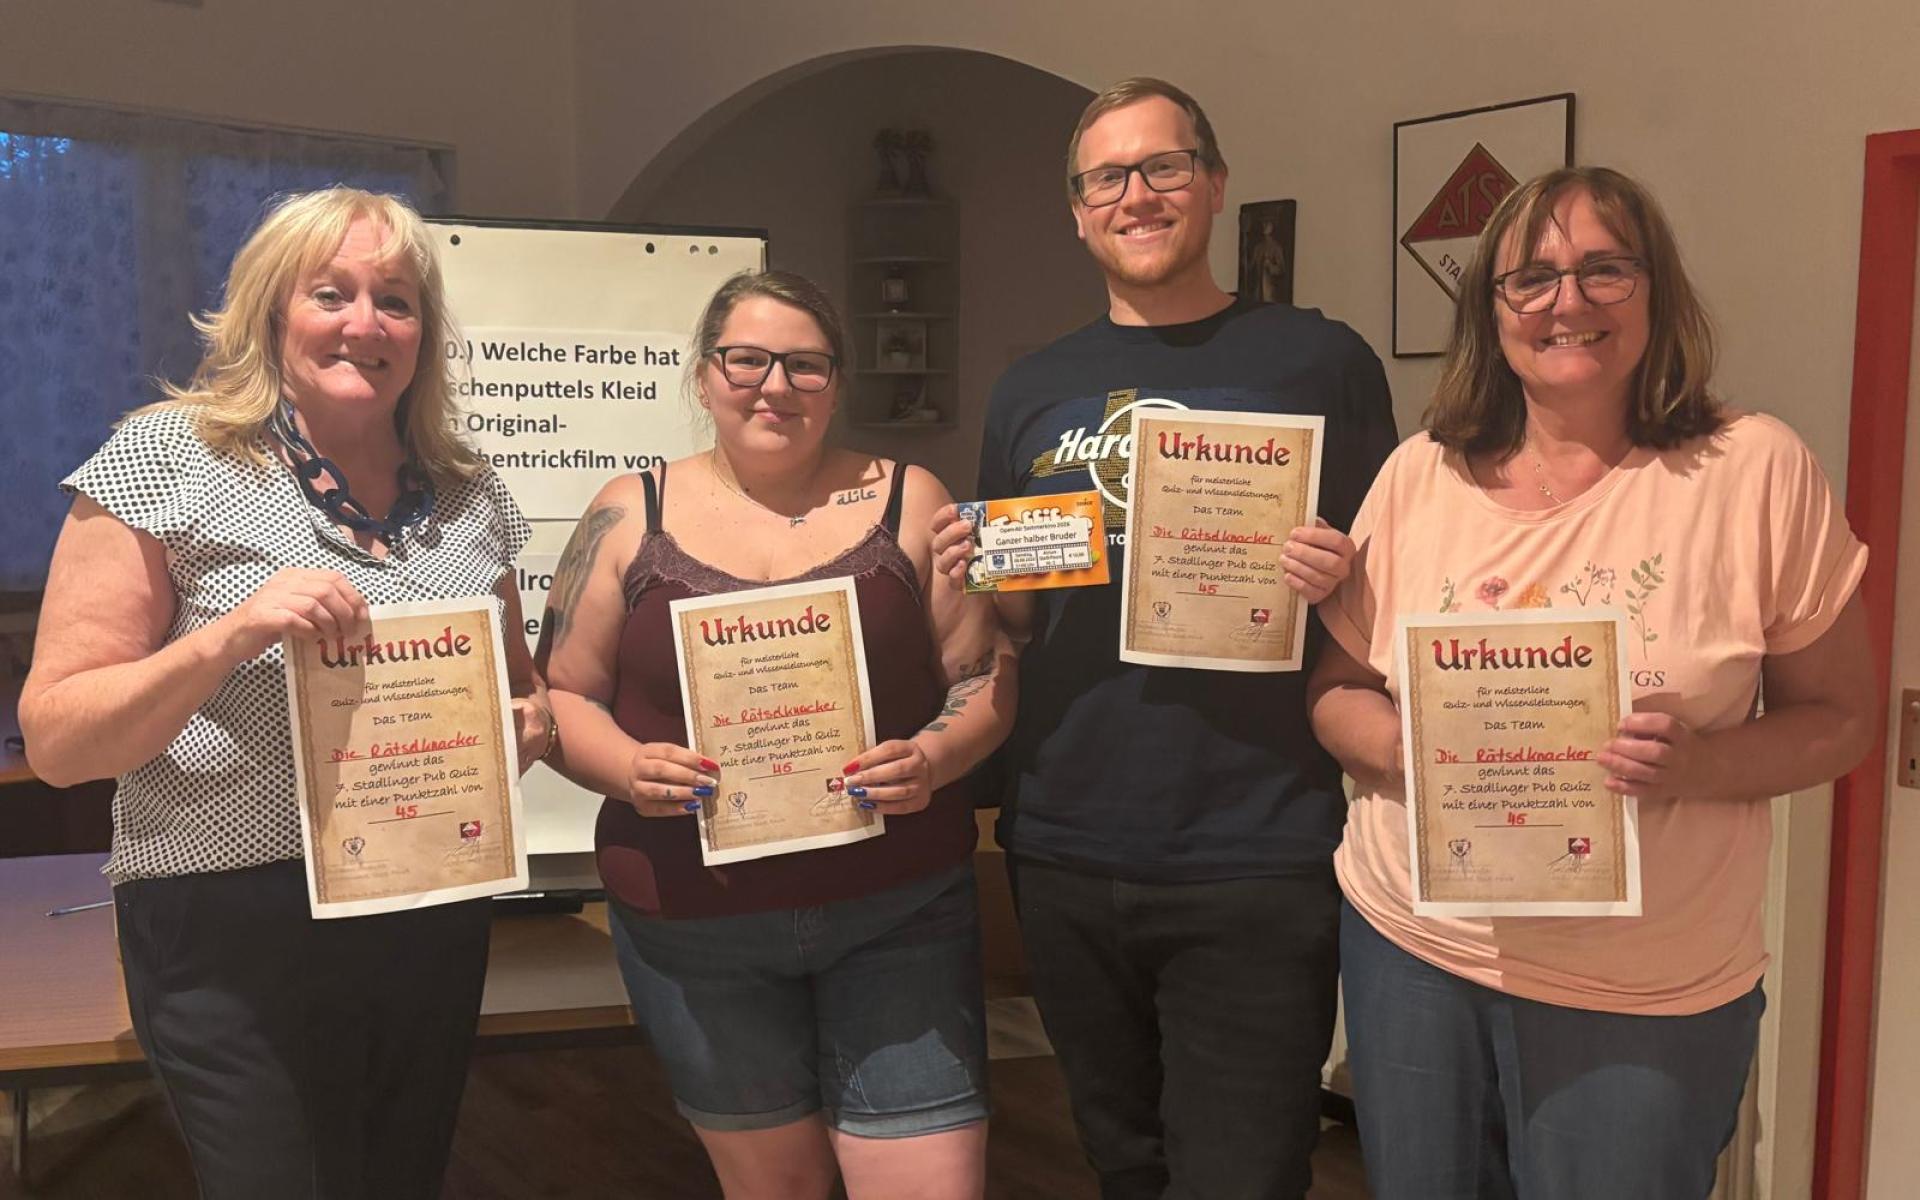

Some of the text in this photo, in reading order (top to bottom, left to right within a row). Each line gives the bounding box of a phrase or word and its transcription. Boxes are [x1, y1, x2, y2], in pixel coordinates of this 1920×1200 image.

[1437, 172, 1503, 230] ATS
[1439, 254, 1462, 282] STA
[446, 340, 680, 366] 0.) Welche Farbe hat
[449, 377, 657, 402] schenputtels Kleid
[468, 413, 567, 437] Original-
[1158, 431, 1290, 466] Urkunde
[478, 448, 664, 469] hentrickfilm von
[1191, 475, 1252, 486] für meisterliche
[1161, 485, 1280, 500] Quiz- und Wissensleistungen
[1194, 506, 1244, 516] Das Team
[996, 532, 1076, 545] Ganzer halber Bruder
[1152, 526, 1173, 538] Die
[1183, 544, 1247, 556] gewinnt das
[1154, 555, 1276, 571] 7. Stadlinger Pub Quiz
[1152, 569, 1171, 578] mit
[1172, 570, 1198, 579] einer
[1200, 571, 1255, 584] Punktzahl
[1199, 583, 1219, 594] 45
[700, 605, 831, 647] Urkunde
[318, 626, 471, 668] Urkunde
[1432, 636, 1592, 671] Urkunde
[740, 651, 799, 667] für meisterliche
[713, 660, 829, 680] Quiz- und Wissensleistungen
[365, 676, 435, 694] für meisterliche
[749, 682, 799, 694] Das Team
[1476, 686, 1550, 698] für meisterliche
[331, 686, 468, 707] Quiz- und Wissensleistungen
[1443, 698, 1585, 709] Quiz- und Wissensleistungen
[373, 712, 433, 726] Das Team
[713, 714, 730, 726] Die
[1484, 720, 1545, 730] Das Team
[747, 718, 810, 736] gewinnt das
[720, 728, 840, 754] 7. Stadlinger Pub Quiz
[332, 750, 357, 761] Die
[720, 745, 845, 767] mit einer Punktzahl von
[1436, 749, 1458, 762] Die
[369, 755, 444, 776] gewinnt das
[773, 763, 792, 774] 45
[1478, 766, 1555, 780] gewinnt das
[335, 767, 479, 796] 7. Stadlinger Pub Quiz
[1444, 782, 1591, 796] 7. Stadlinger Pub Quiz
[335, 784, 483, 809] mit einer Punktzahl von
[396, 804, 417, 819] 45
[1442, 799, 1595, 810] mit einer Punktzahl von
[1508, 812, 1528, 826] 45
